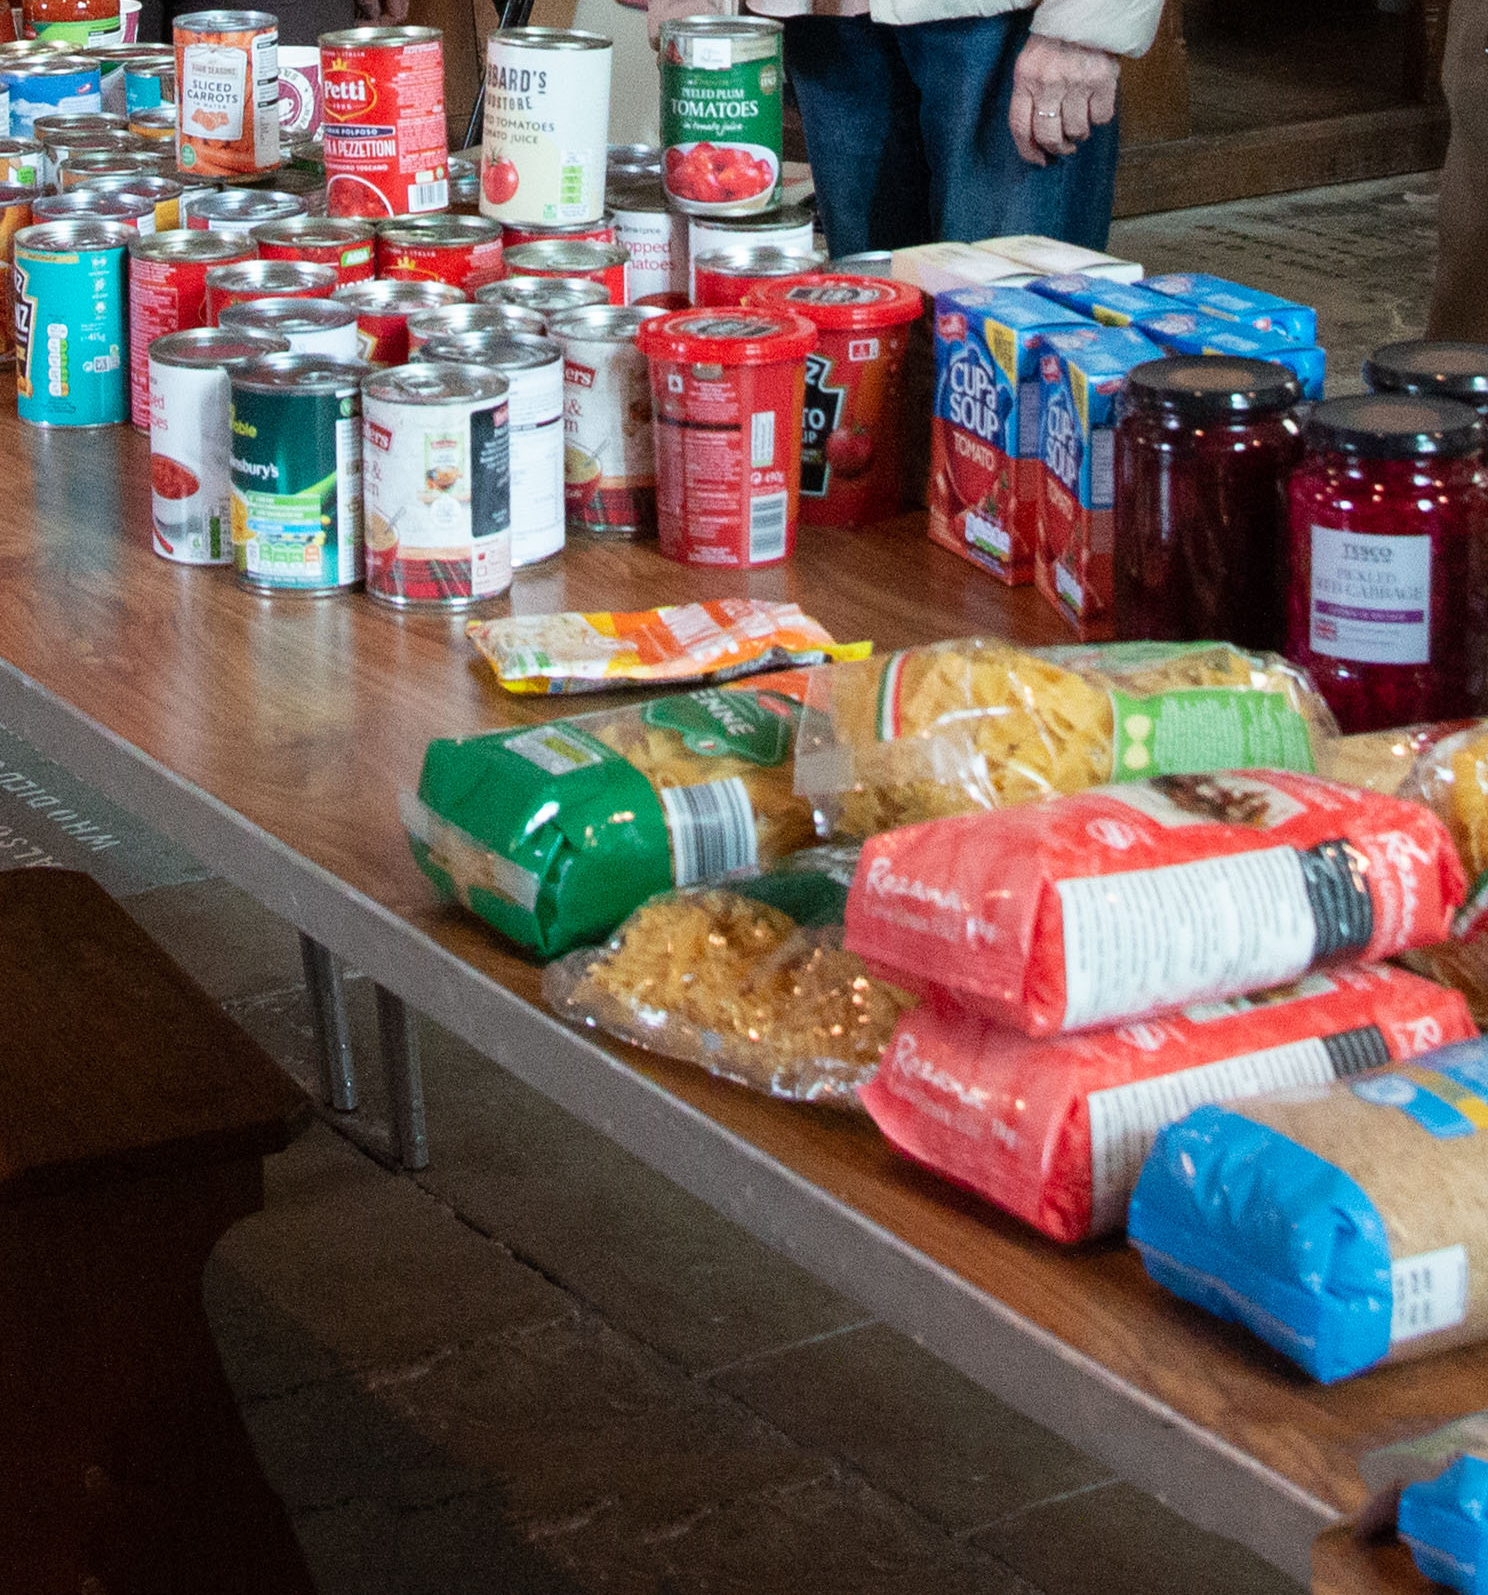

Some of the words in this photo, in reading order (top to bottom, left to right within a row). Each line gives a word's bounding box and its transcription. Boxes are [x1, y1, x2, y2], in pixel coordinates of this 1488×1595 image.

[187, 90, 238, 103] CARROTS
[192, 80, 232, 92] SLICED
[324, 80, 366, 101] Petti
[716, 89, 744, 99] PLUM
[671, 98, 758, 118] TOMATOES
[496, 117, 555, 132] TOMATOES
[950, 362, 986, 397] CUP
[950, 399, 999, 441] SOUP
[952, 430, 995, 472] TOMATO
[1046, 440, 1077, 487] SOUP
[39, 807, 128, 851] WHO
